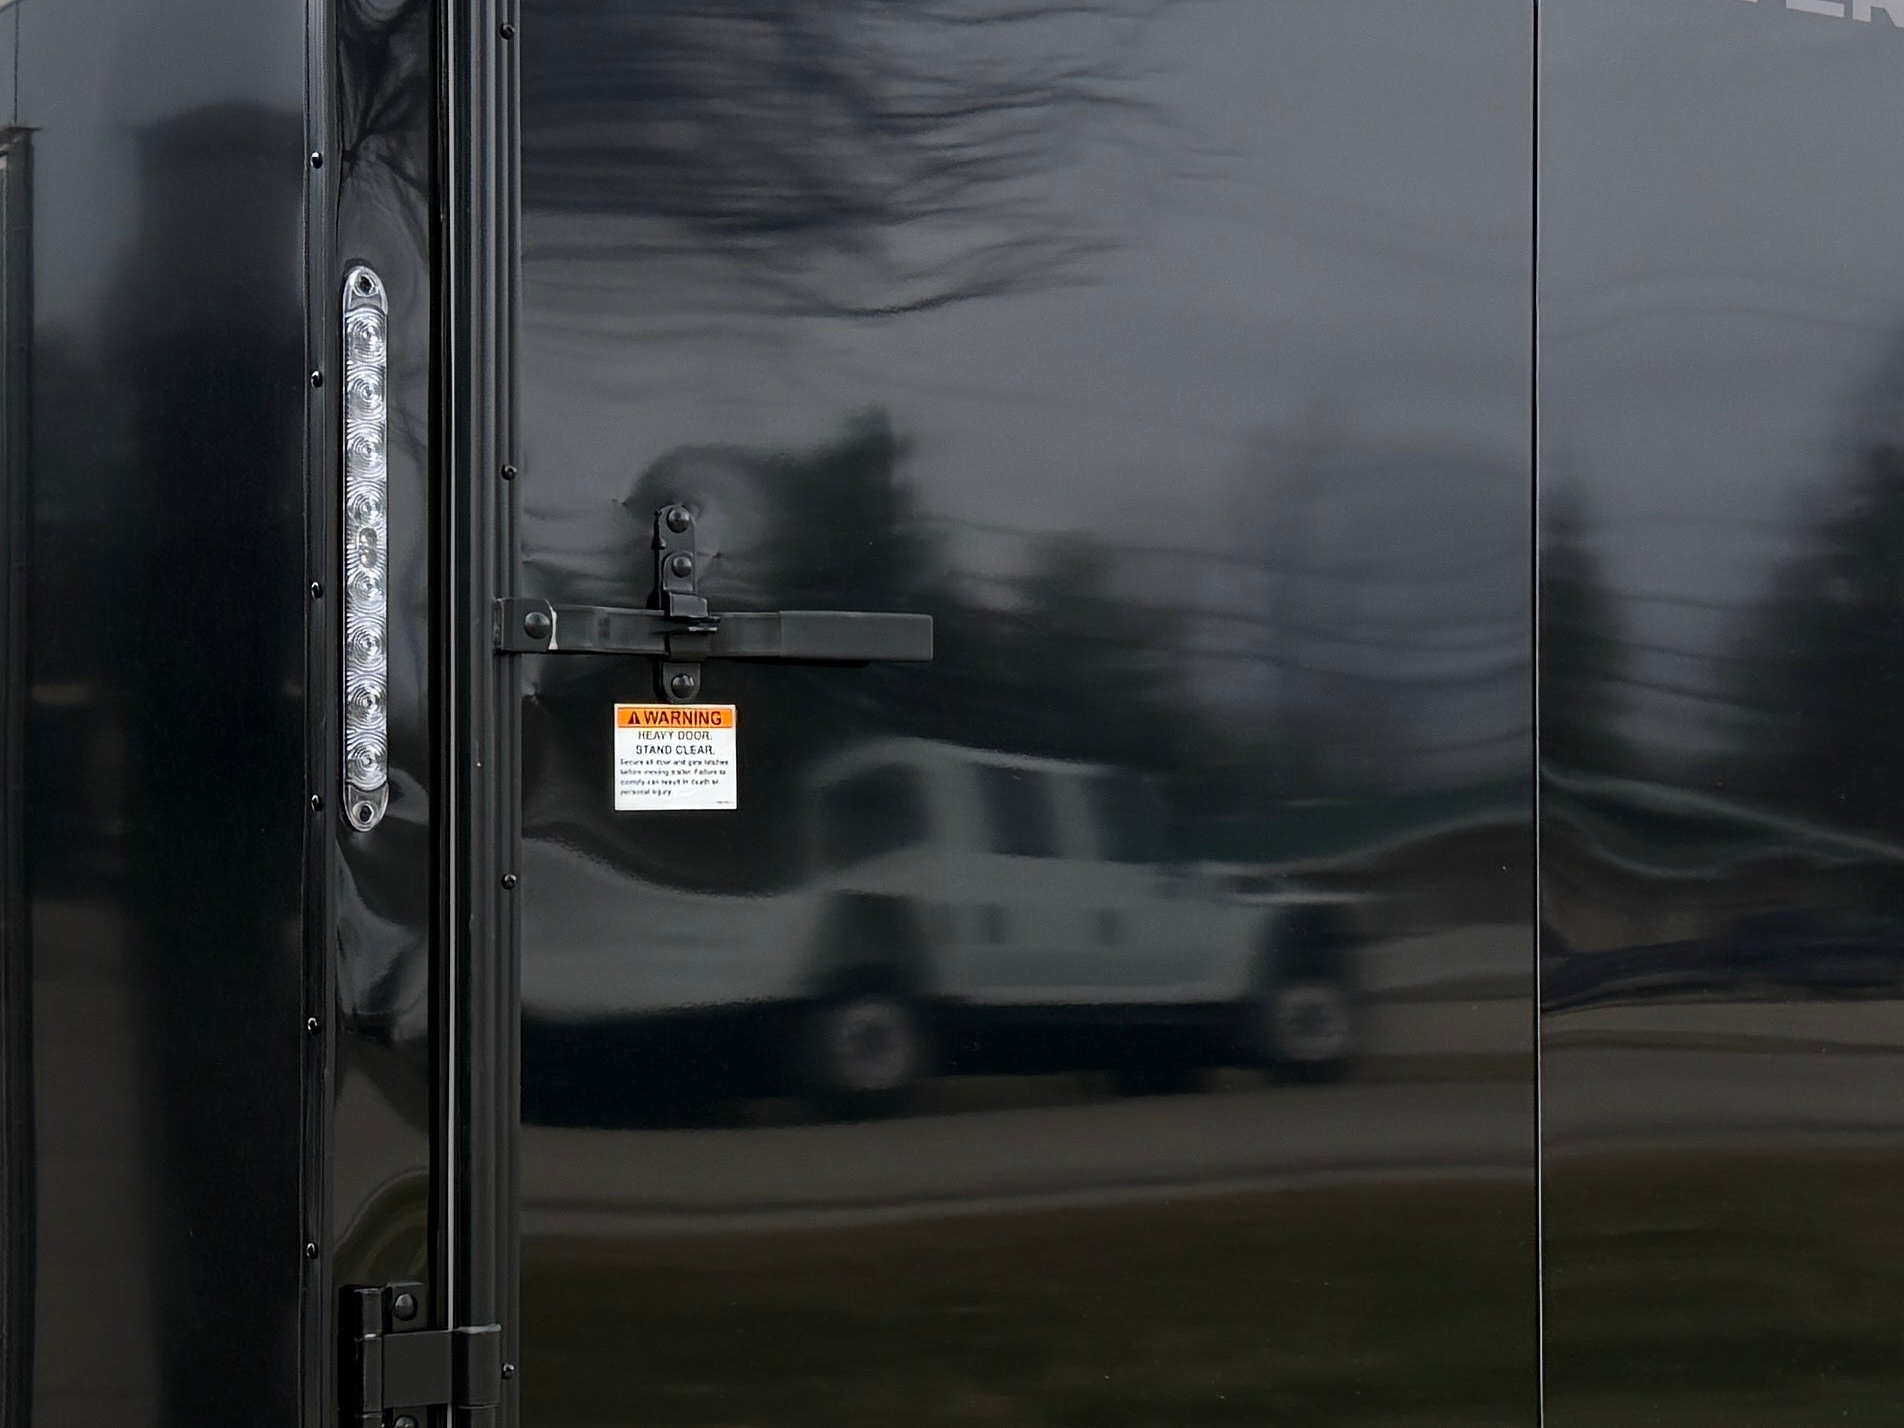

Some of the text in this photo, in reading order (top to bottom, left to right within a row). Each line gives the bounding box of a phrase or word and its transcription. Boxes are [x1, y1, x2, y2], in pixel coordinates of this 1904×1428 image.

[643, 710, 722, 725] WARNING
[638, 730, 674, 740] HEAVY
[636, 745, 672, 755] STAND
